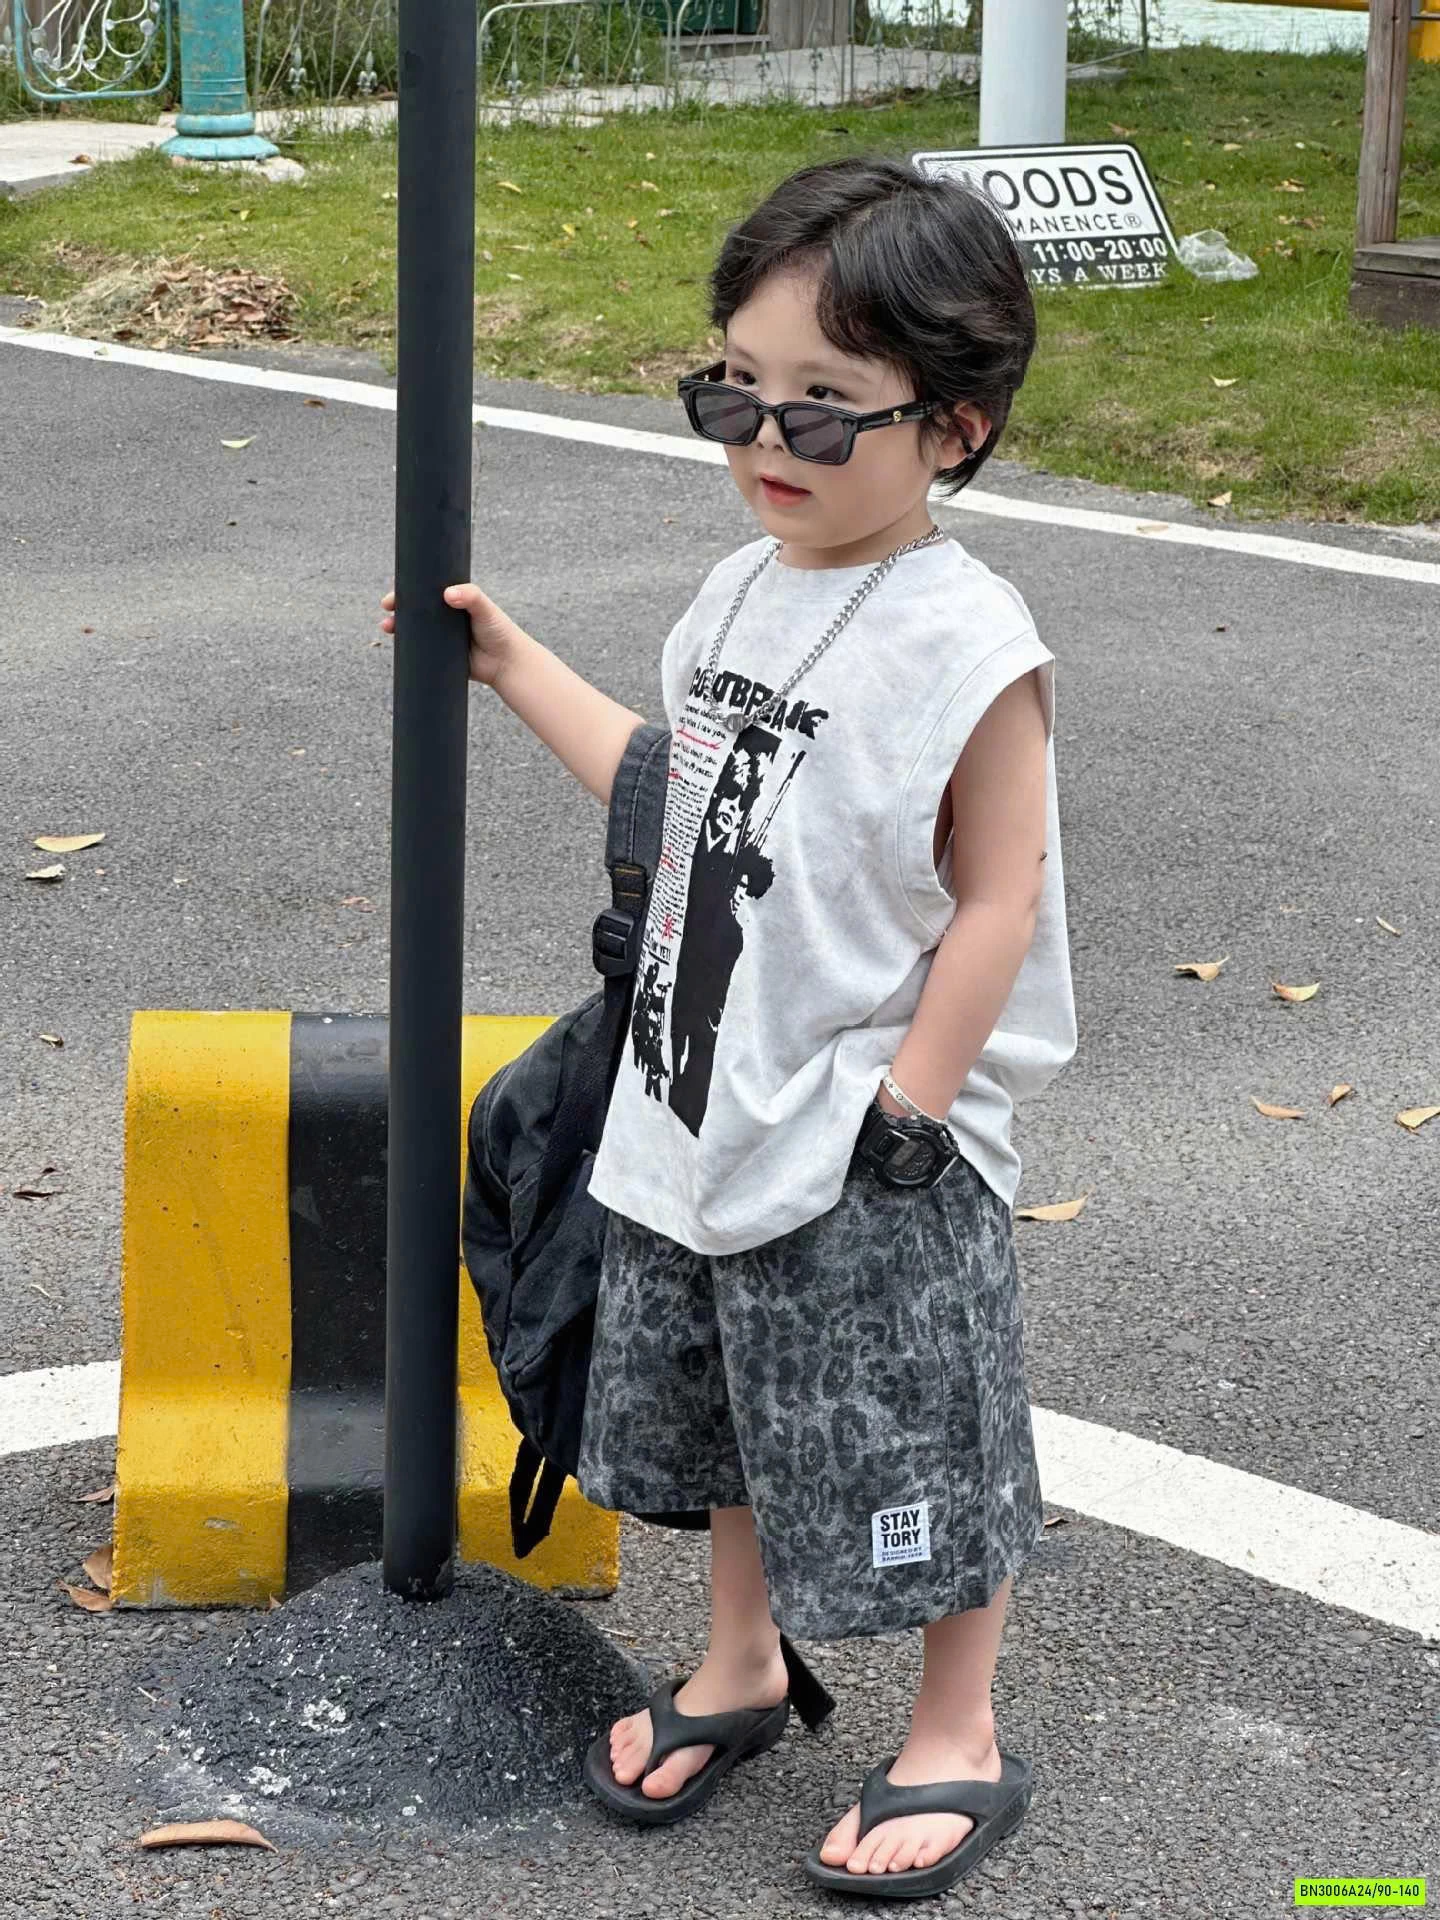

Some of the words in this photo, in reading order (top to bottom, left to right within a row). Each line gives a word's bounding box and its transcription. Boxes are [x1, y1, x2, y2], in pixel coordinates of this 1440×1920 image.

[961, 165, 1133, 211] OODS
[1032, 237, 1169, 263] 11:00-20:00
[1073, 267, 1090, 282] A
[1097, 262, 1168, 281] WEEK
[880, 1509, 920, 1532] STAY
[881, 1528, 921, 1549] TORY
